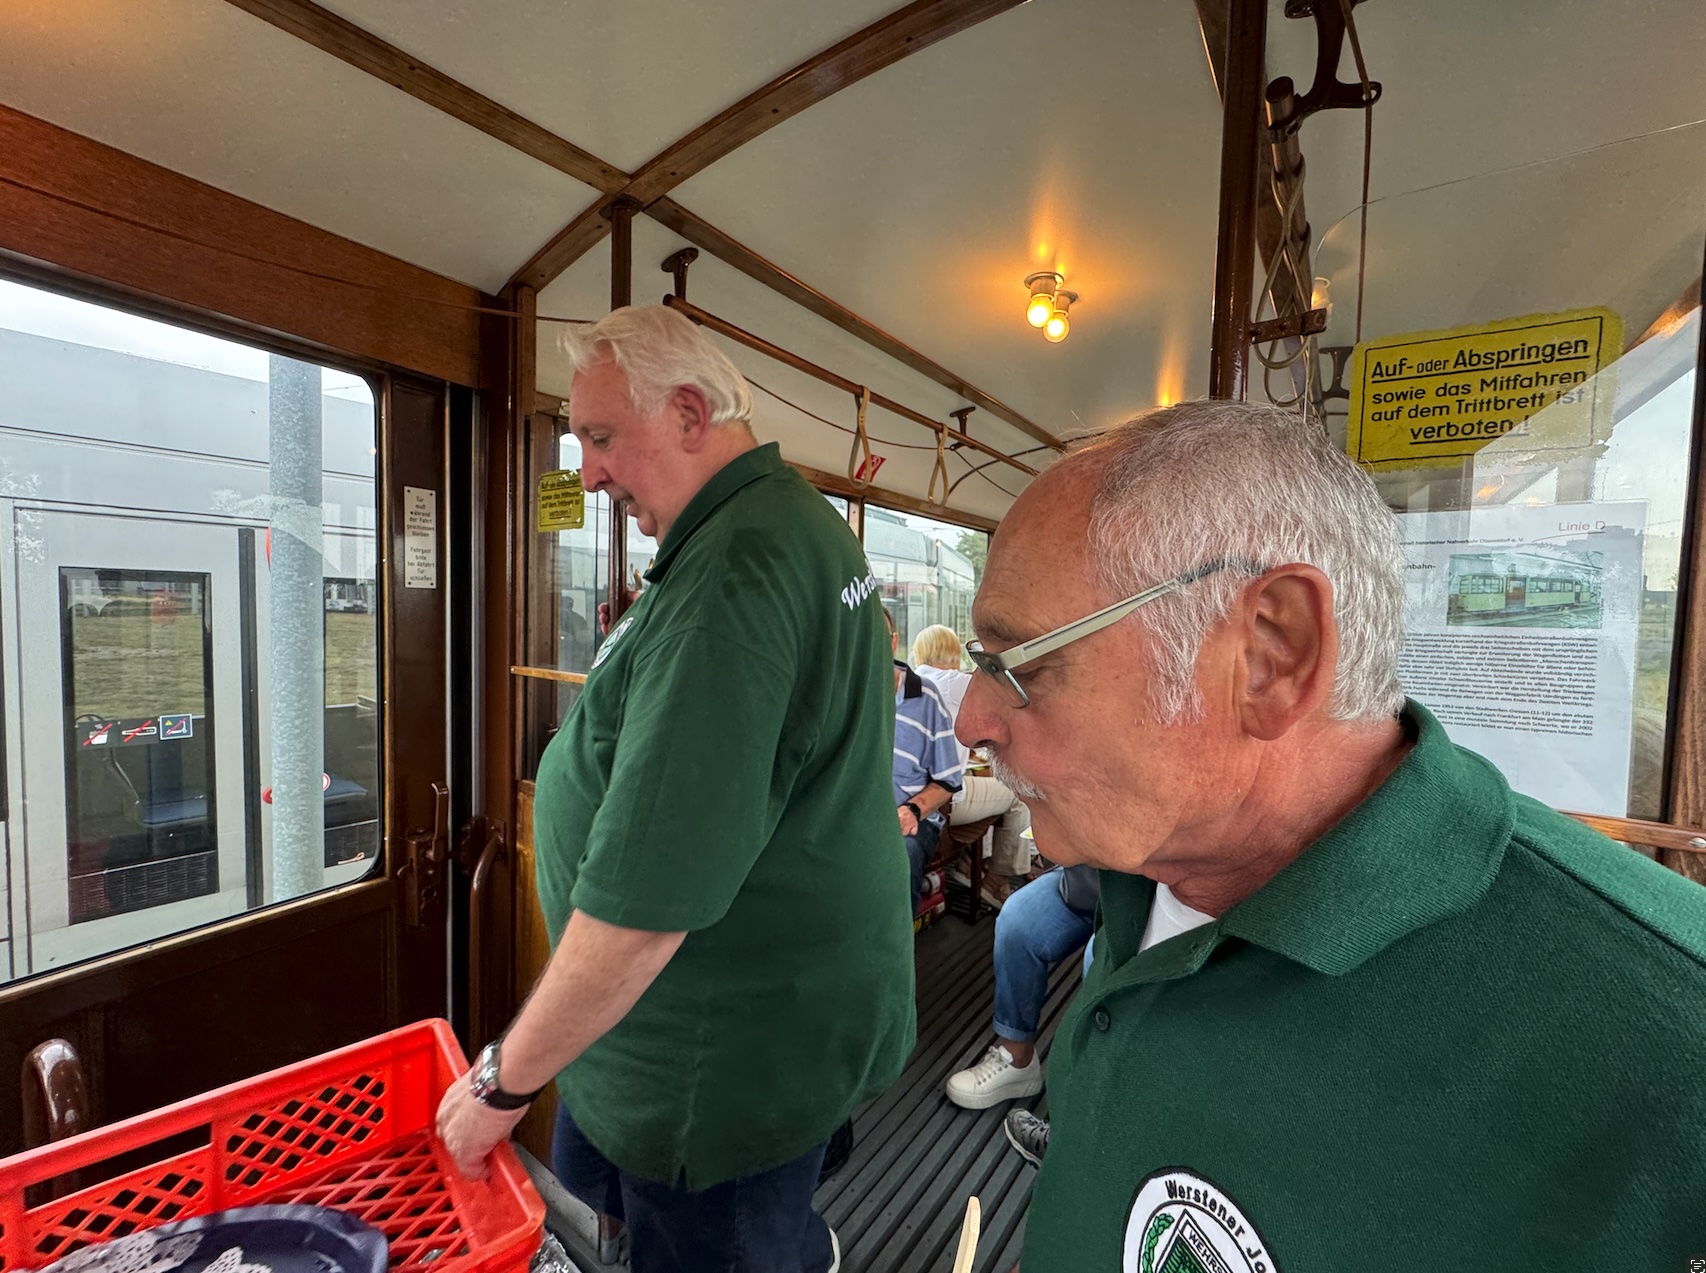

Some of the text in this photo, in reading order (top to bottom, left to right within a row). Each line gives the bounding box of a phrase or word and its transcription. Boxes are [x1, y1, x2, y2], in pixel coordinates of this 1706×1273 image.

[1371, 339, 1588, 379] Auf- oder Abspringen
[1371, 387, 1585, 422] auf dem Trittbrett ist
[1372, 369, 1587, 405] sowie das Mitfahren
[1558, 520, 1606, 531] Linie D
[1165, 1179, 1246, 1238] Werstener
